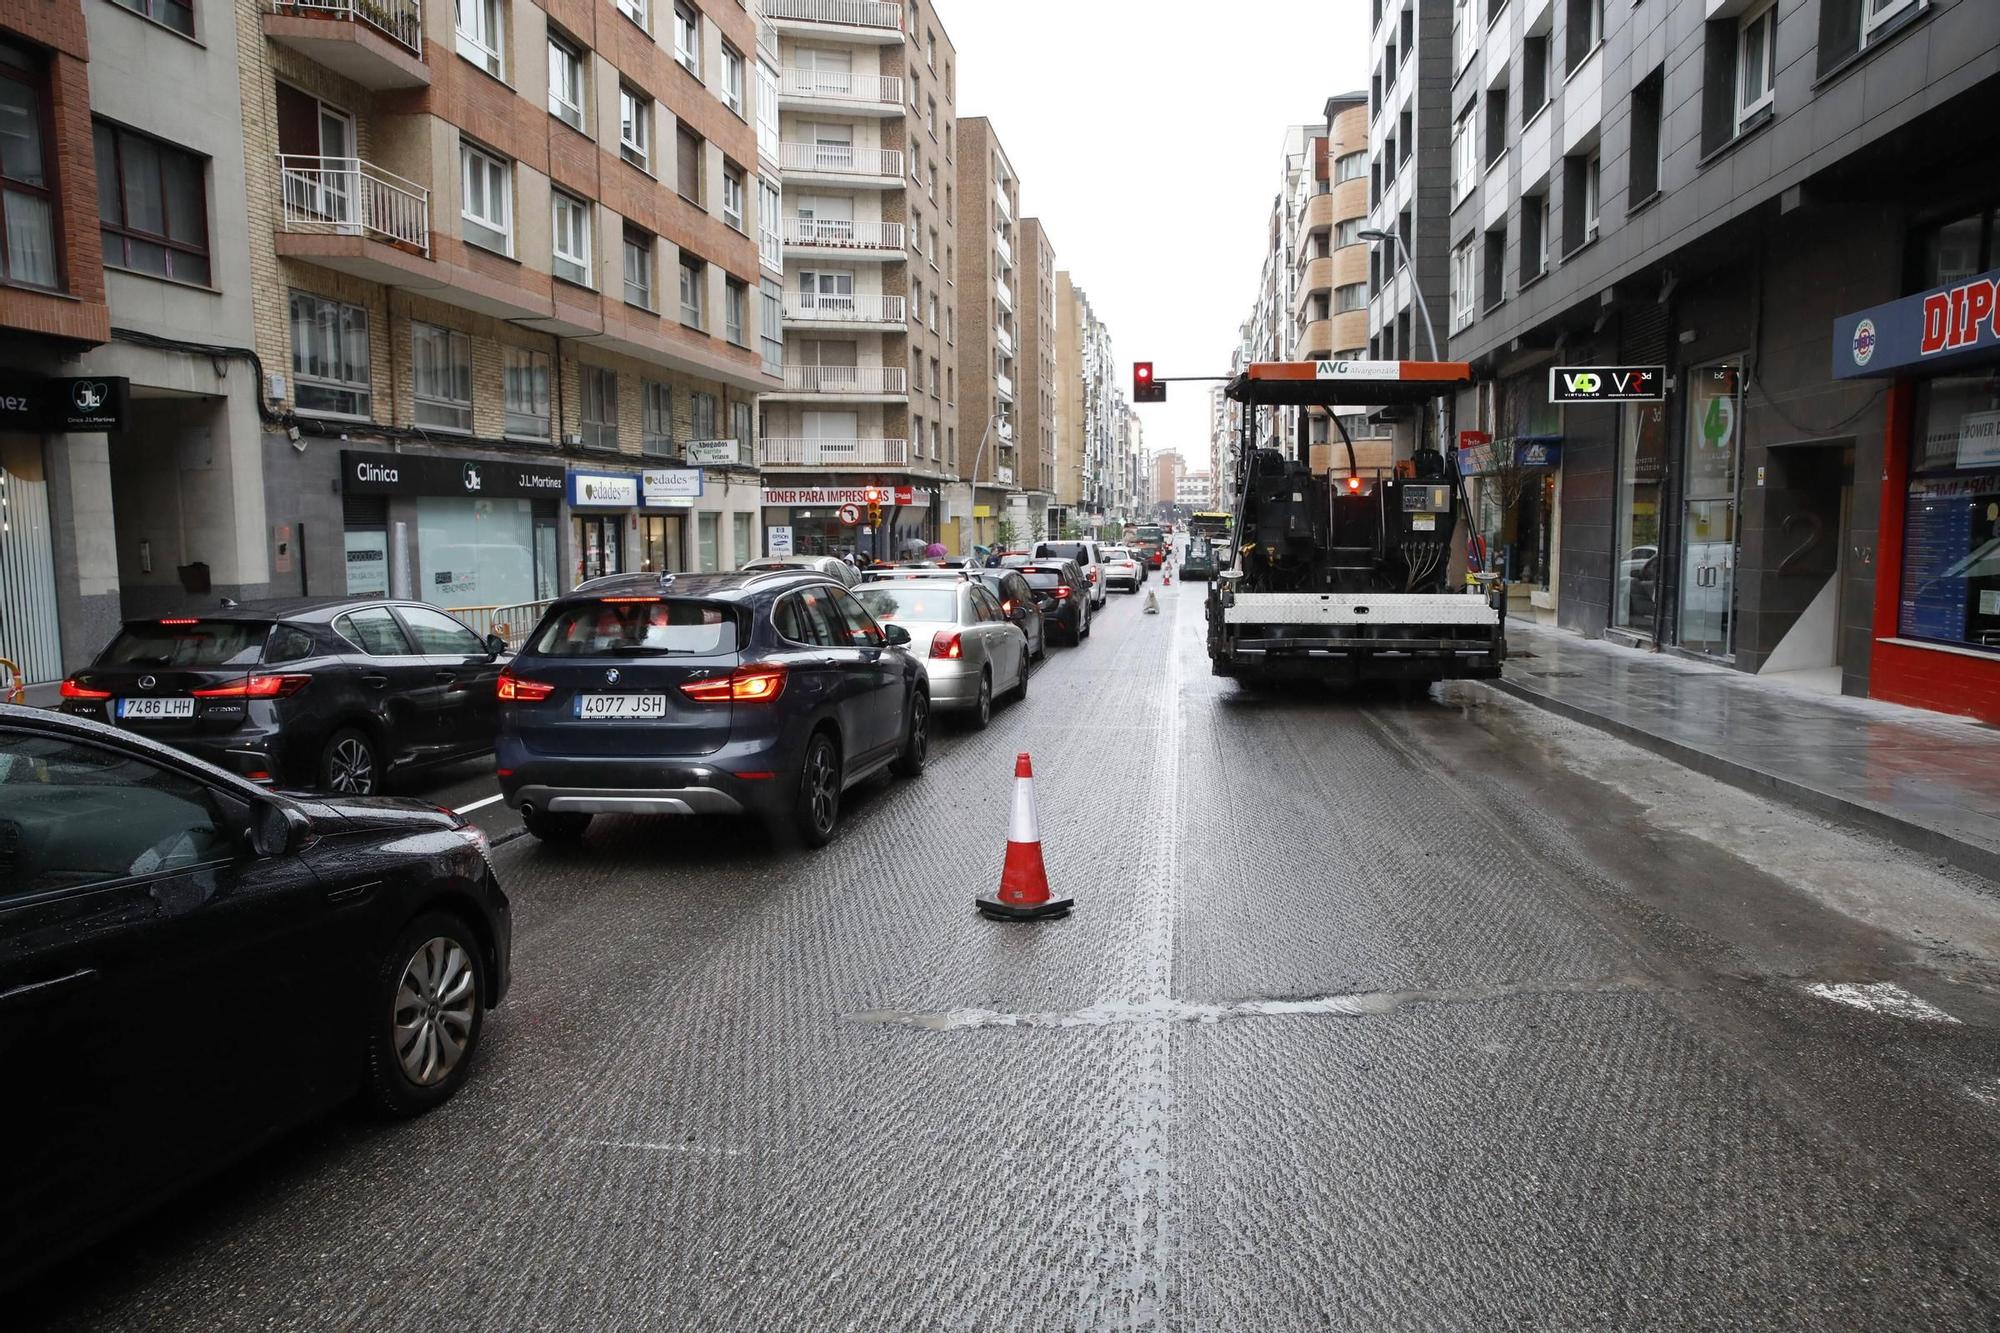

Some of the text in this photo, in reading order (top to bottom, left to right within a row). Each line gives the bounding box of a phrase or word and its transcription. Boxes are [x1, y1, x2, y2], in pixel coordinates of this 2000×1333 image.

[1920, 279, 2000, 356] DIP
[1318, 361, 1349, 374] AVG
[653, 474, 688, 485] edades
[593, 482, 621, 500] edades
[765, 490, 797, 503] TONER
[799, 490, 825, 503] PARA
[827, 490, 889, 503] IMPRESOAS
[688, 669, 710, 678] X1
[127, 700, 191, 714] 7486 LHH
[585, 697, 662, 713] 4077 JSH
